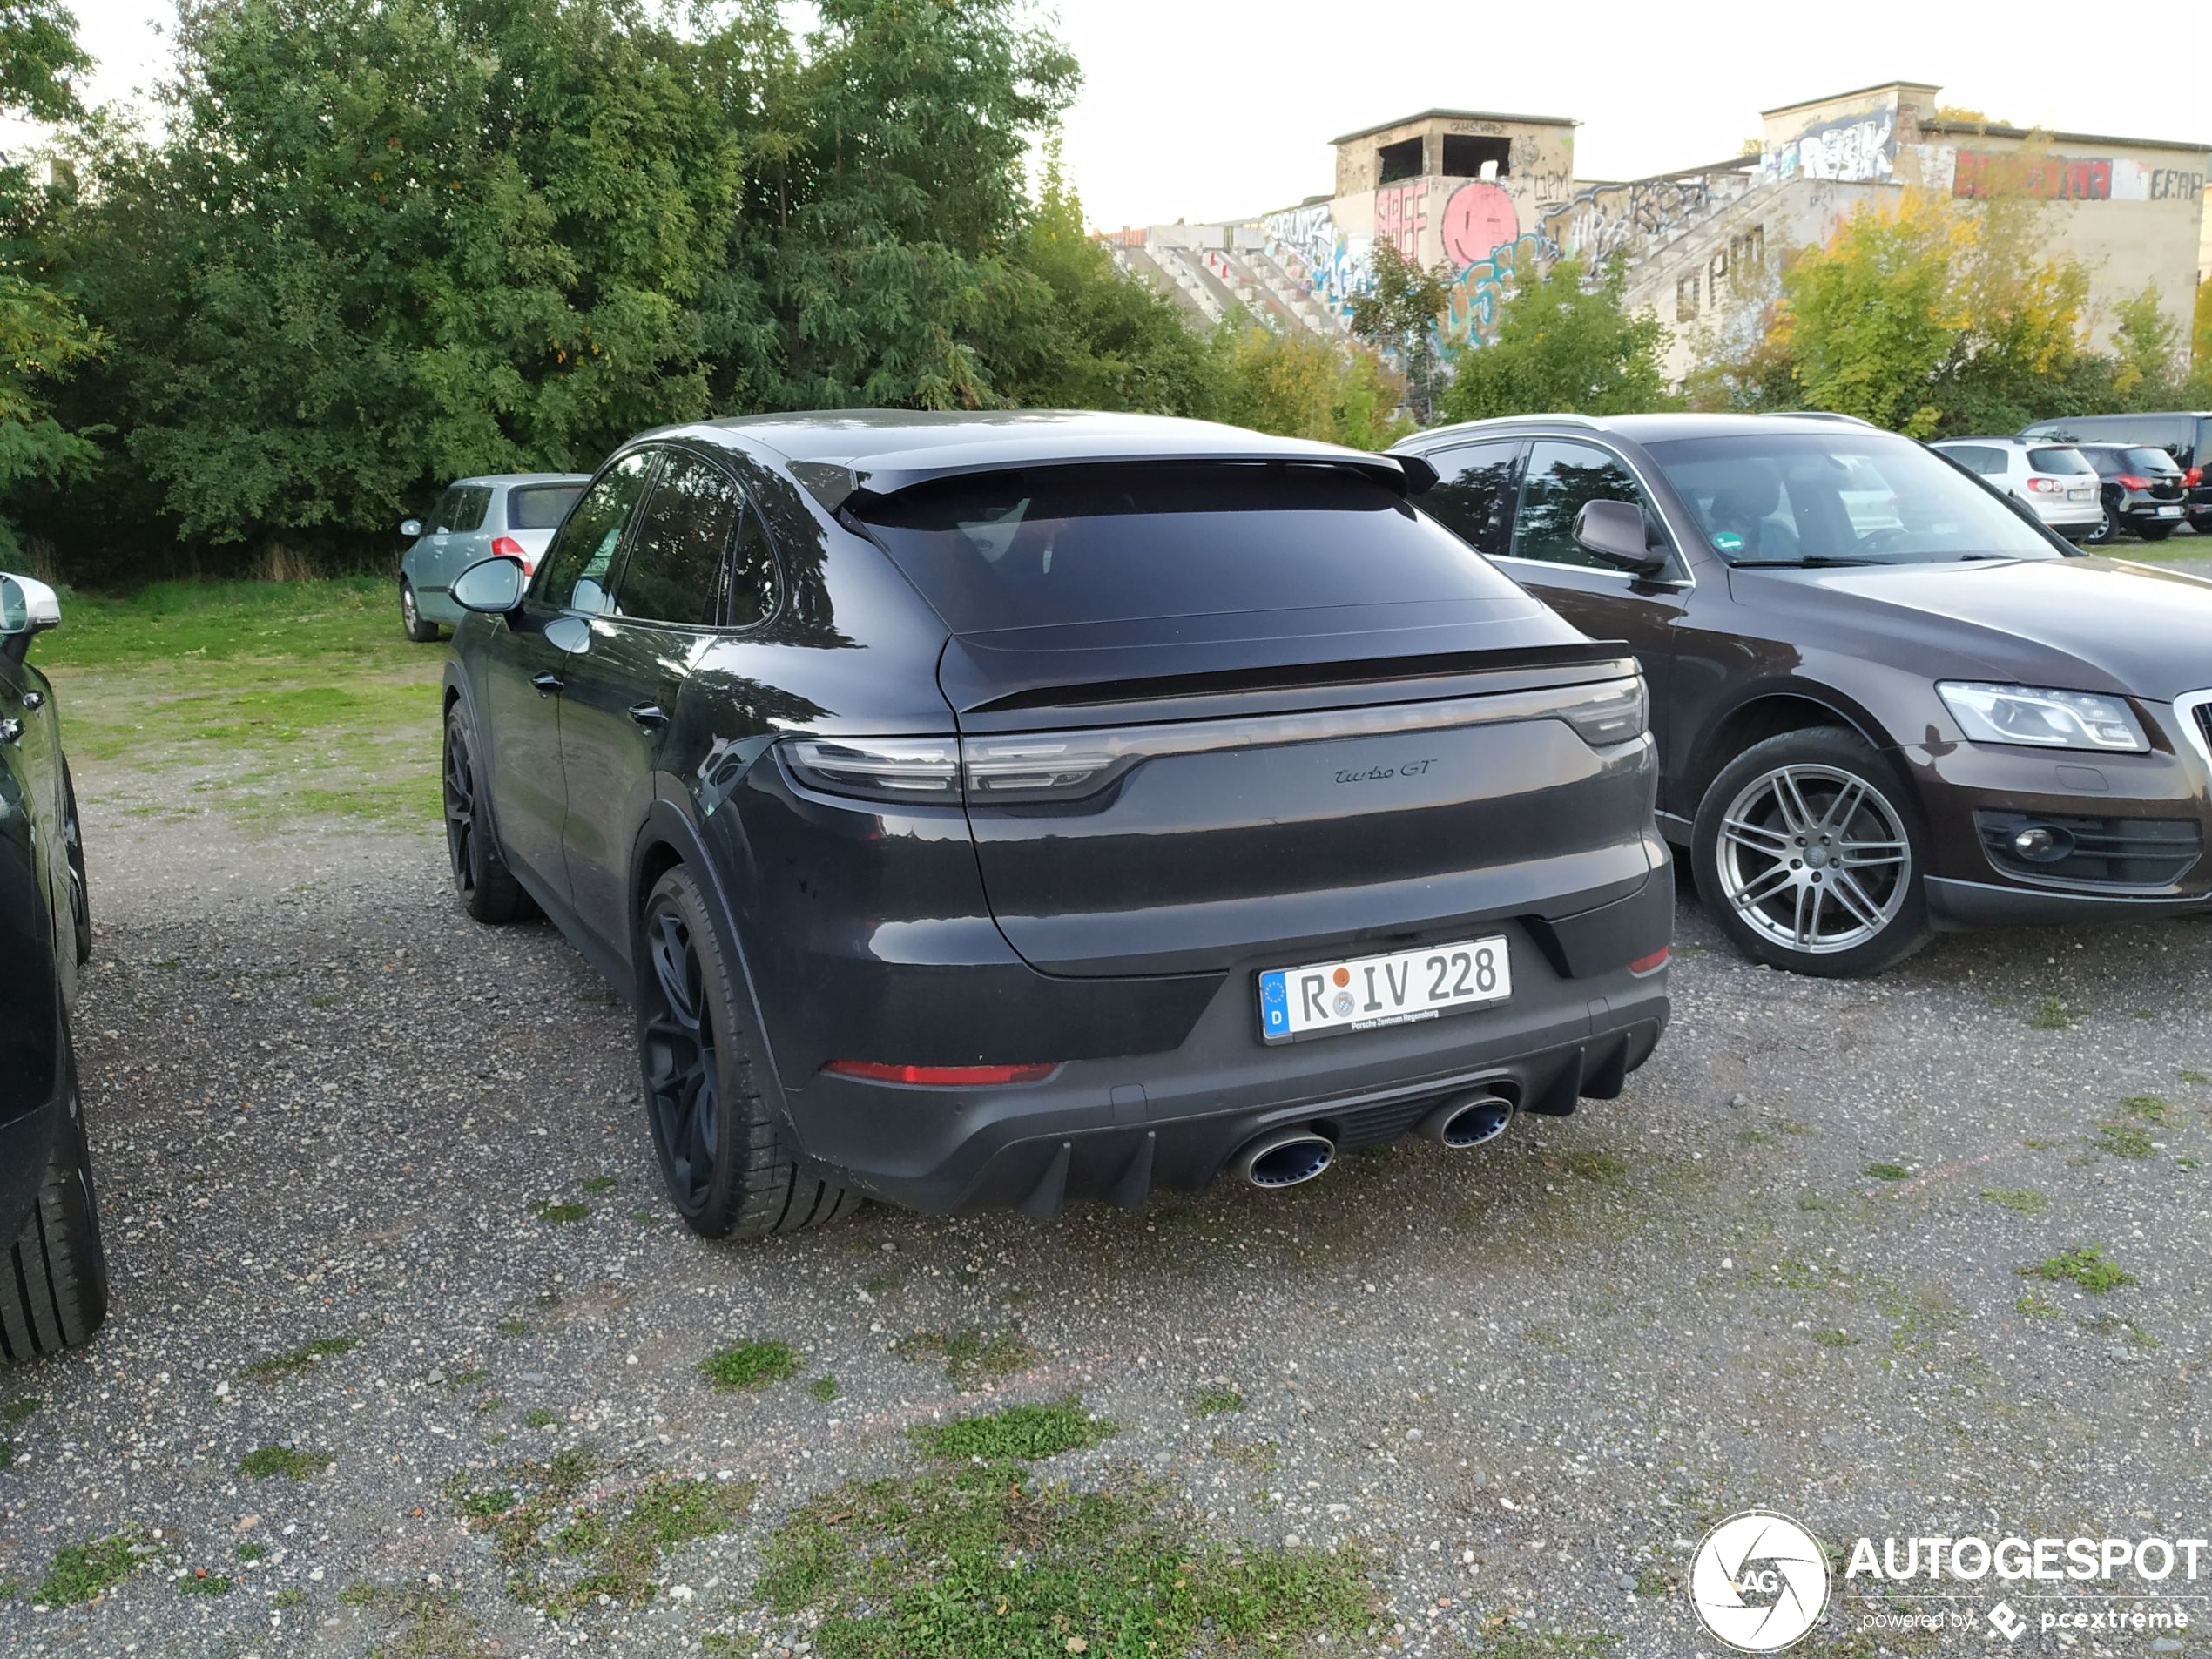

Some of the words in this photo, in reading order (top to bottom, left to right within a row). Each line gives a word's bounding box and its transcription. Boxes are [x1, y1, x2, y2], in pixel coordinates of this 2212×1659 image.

[1400, 758, 1439, 777] GT
[1300, 974, 1329, 1022] R
[1363, 960, 1409, 1013] IV
[1426, 947, 1497, 1001] 228
[1271, 1010, 1282, 1025] D
[1351, 1020, 1377, 1030] Porsche
[1377, 1016, 1403, 1027] Zentrum
[1403, 1009, 1440, 1022] Regensburg
